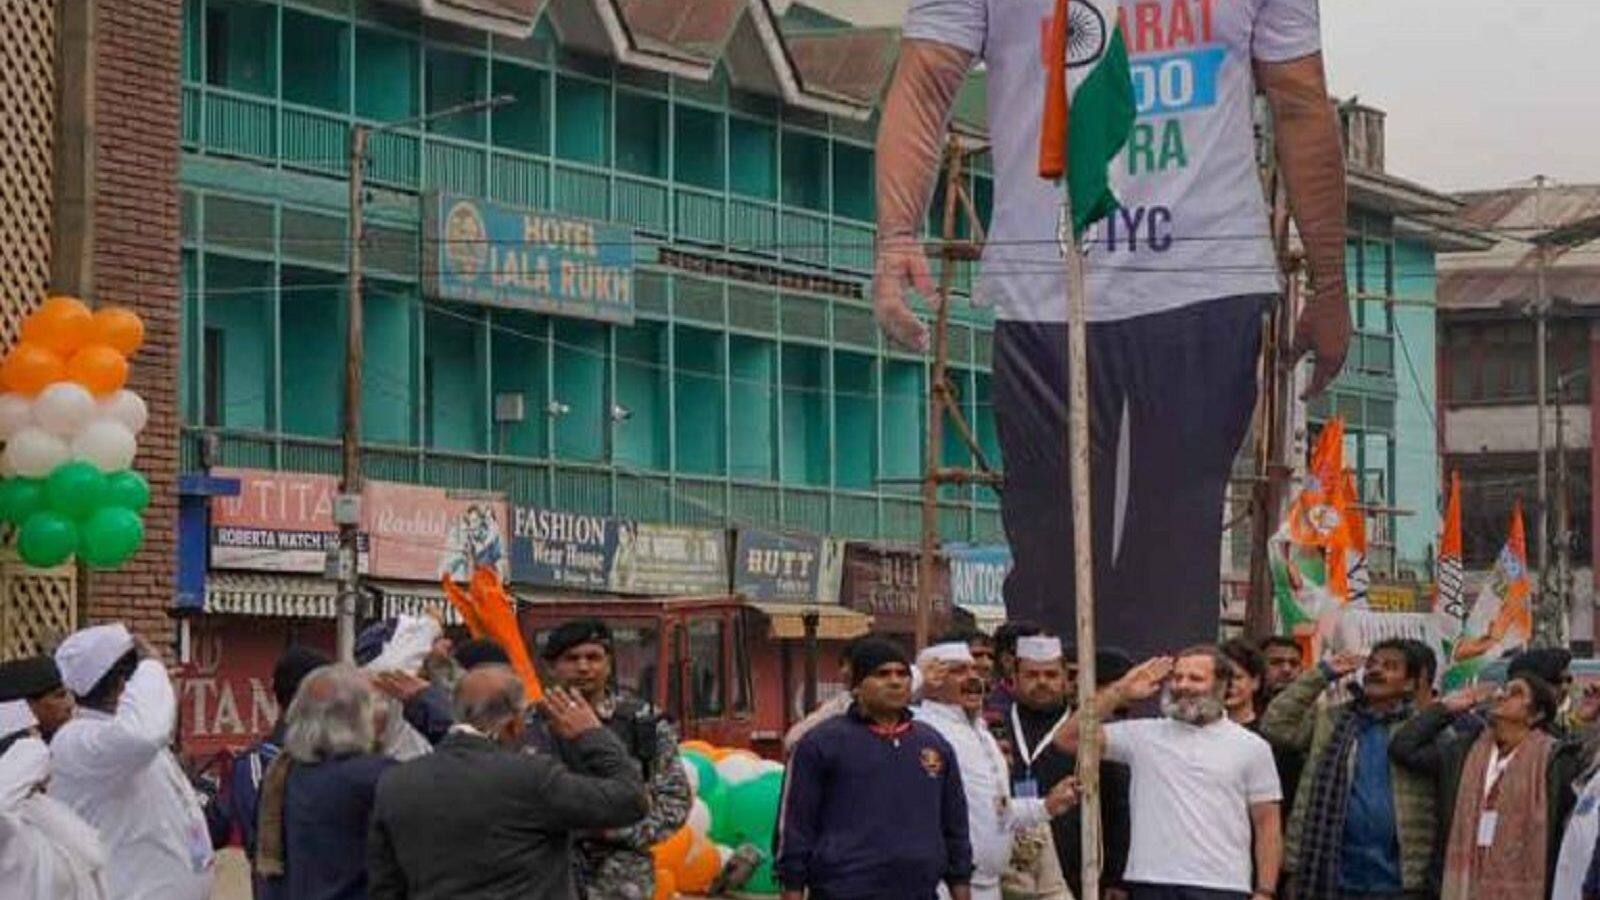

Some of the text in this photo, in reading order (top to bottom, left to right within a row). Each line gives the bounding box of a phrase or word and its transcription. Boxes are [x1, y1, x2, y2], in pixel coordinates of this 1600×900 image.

[1127, 118, 1188, 176] RA
[524, 214, 597, 257] HOTEL
[491, 246, 549, 294] LALA
[561, 258, 633, 305] RUKH
[251, 479, 335, 523] TITA
[218, 528, 276, 547] ROBERTA
[277, 531, 321, 549] WATCH
[514, 506, 606, 546] FASHION
